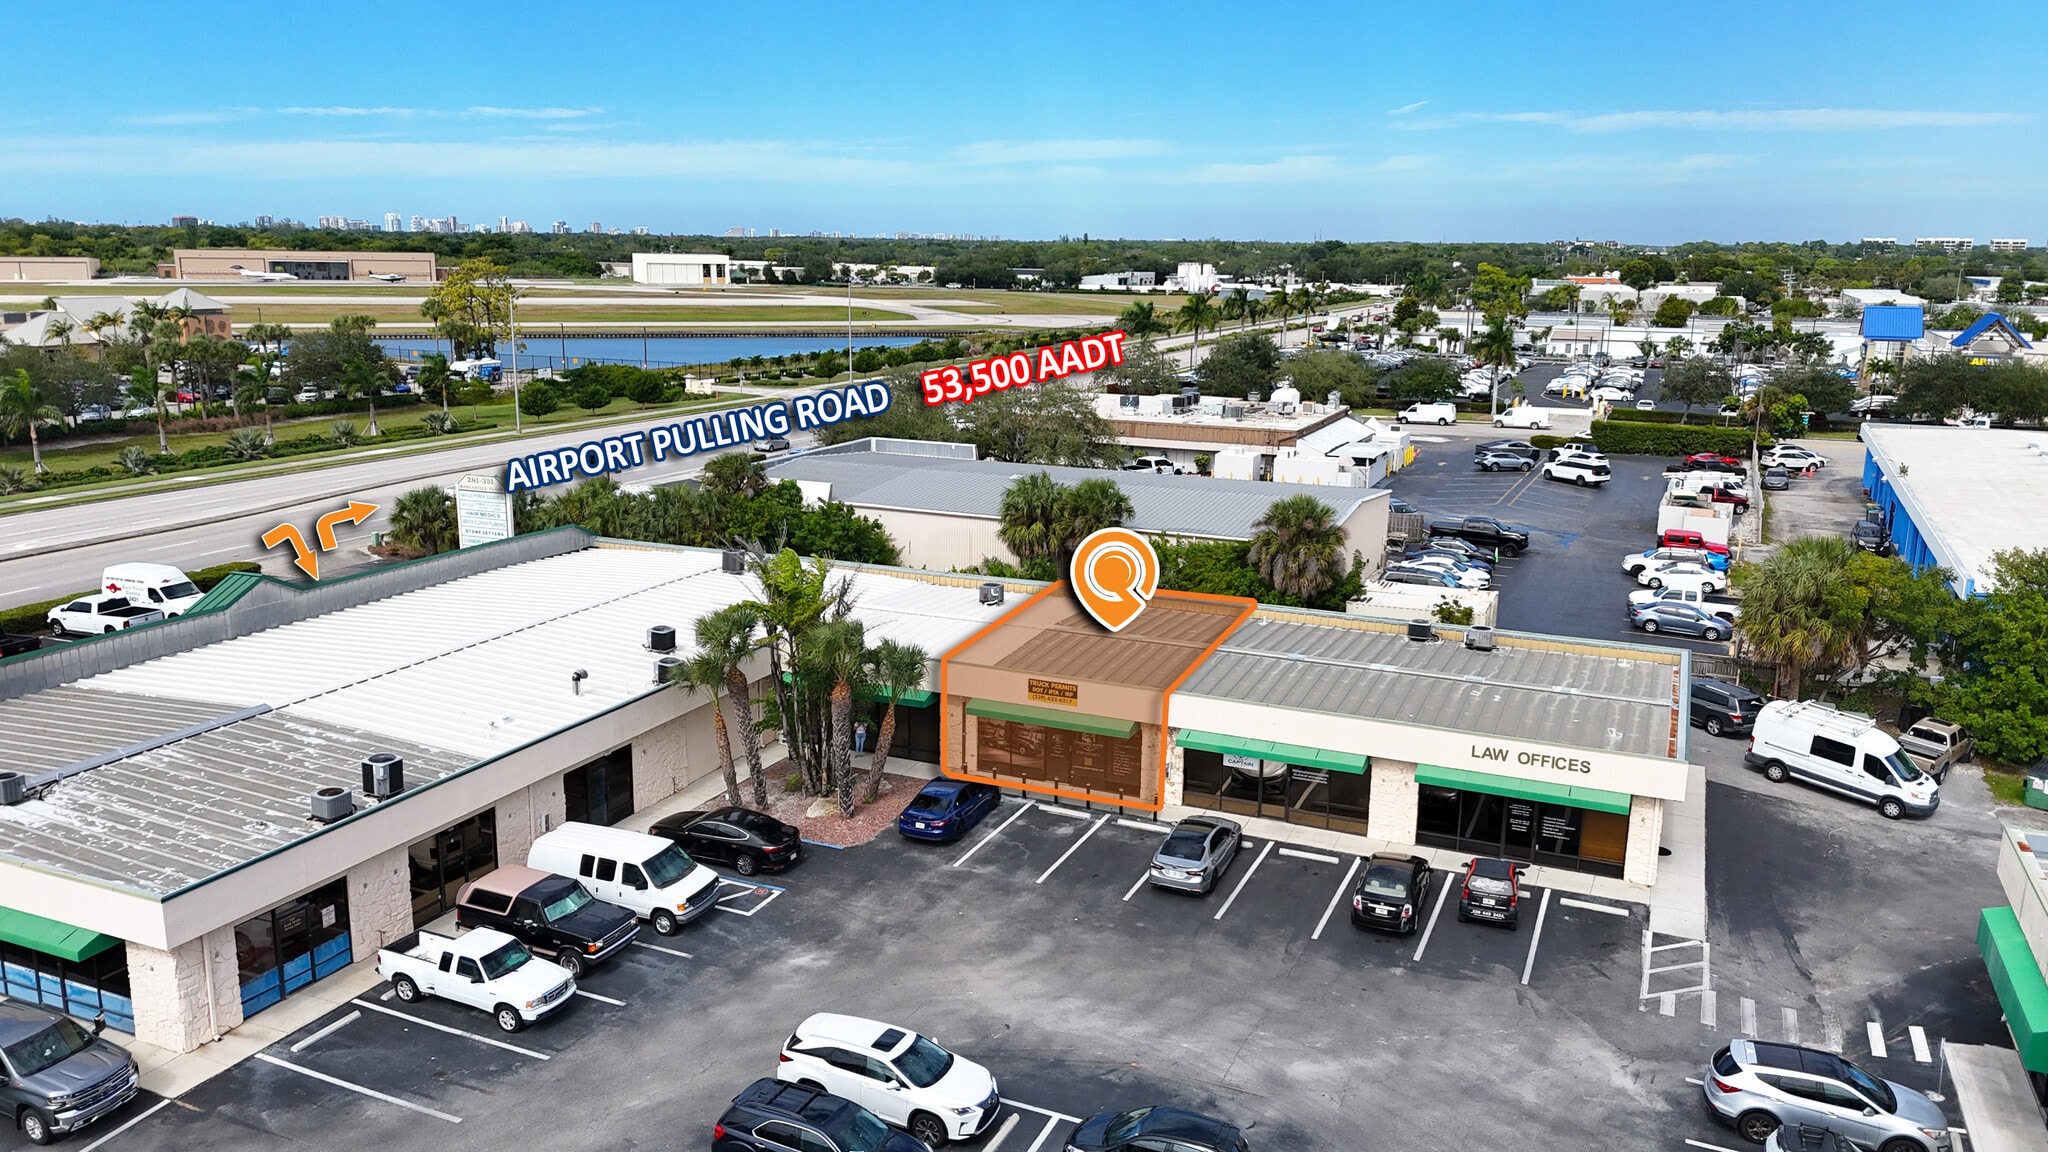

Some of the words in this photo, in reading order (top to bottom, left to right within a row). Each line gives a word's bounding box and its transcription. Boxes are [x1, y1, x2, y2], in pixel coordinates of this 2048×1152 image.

[467, 477, 494, 485] 281-351
[1030, 680, 1050, 689] TRUCK
[1051, 683, 1077, 692] PERMITS
[1227, 758, 1254, 767] CAPTAIN
[1471, 745, 1509, 762] LAW
[1517, 751, 1591, 774] OFFICES
